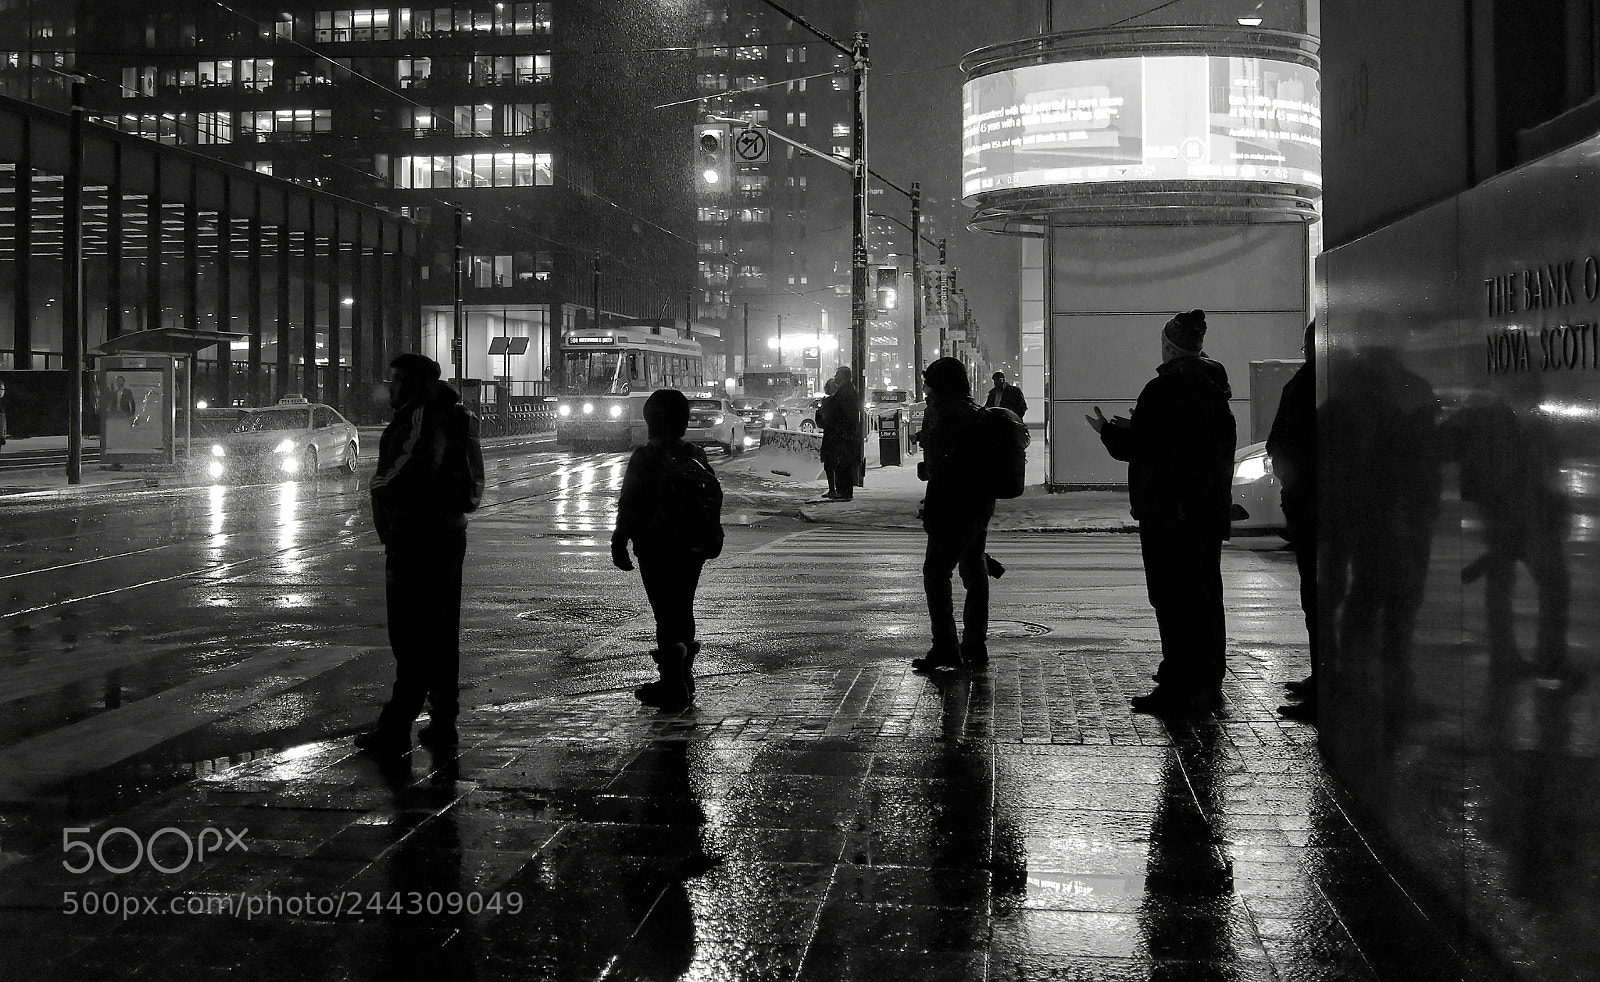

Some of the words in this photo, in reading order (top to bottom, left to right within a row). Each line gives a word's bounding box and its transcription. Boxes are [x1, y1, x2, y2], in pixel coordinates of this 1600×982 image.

[1002, 118, 1015, 128] with
[1020, 103, 1032, 114] the
[1033, 98, 1065, 115] potential
[1067, 99, 1076, 109] to
[1078, 98, 1098, 108] earn
[1100, 98, 1123, 107] more
[1484, 272, 1516, 318] THE
[1522, 260, 1575, 312] BANK
[1486, 330, 1531, 374] NOVA
[1540, 323, 1598, 372] SCOTI
